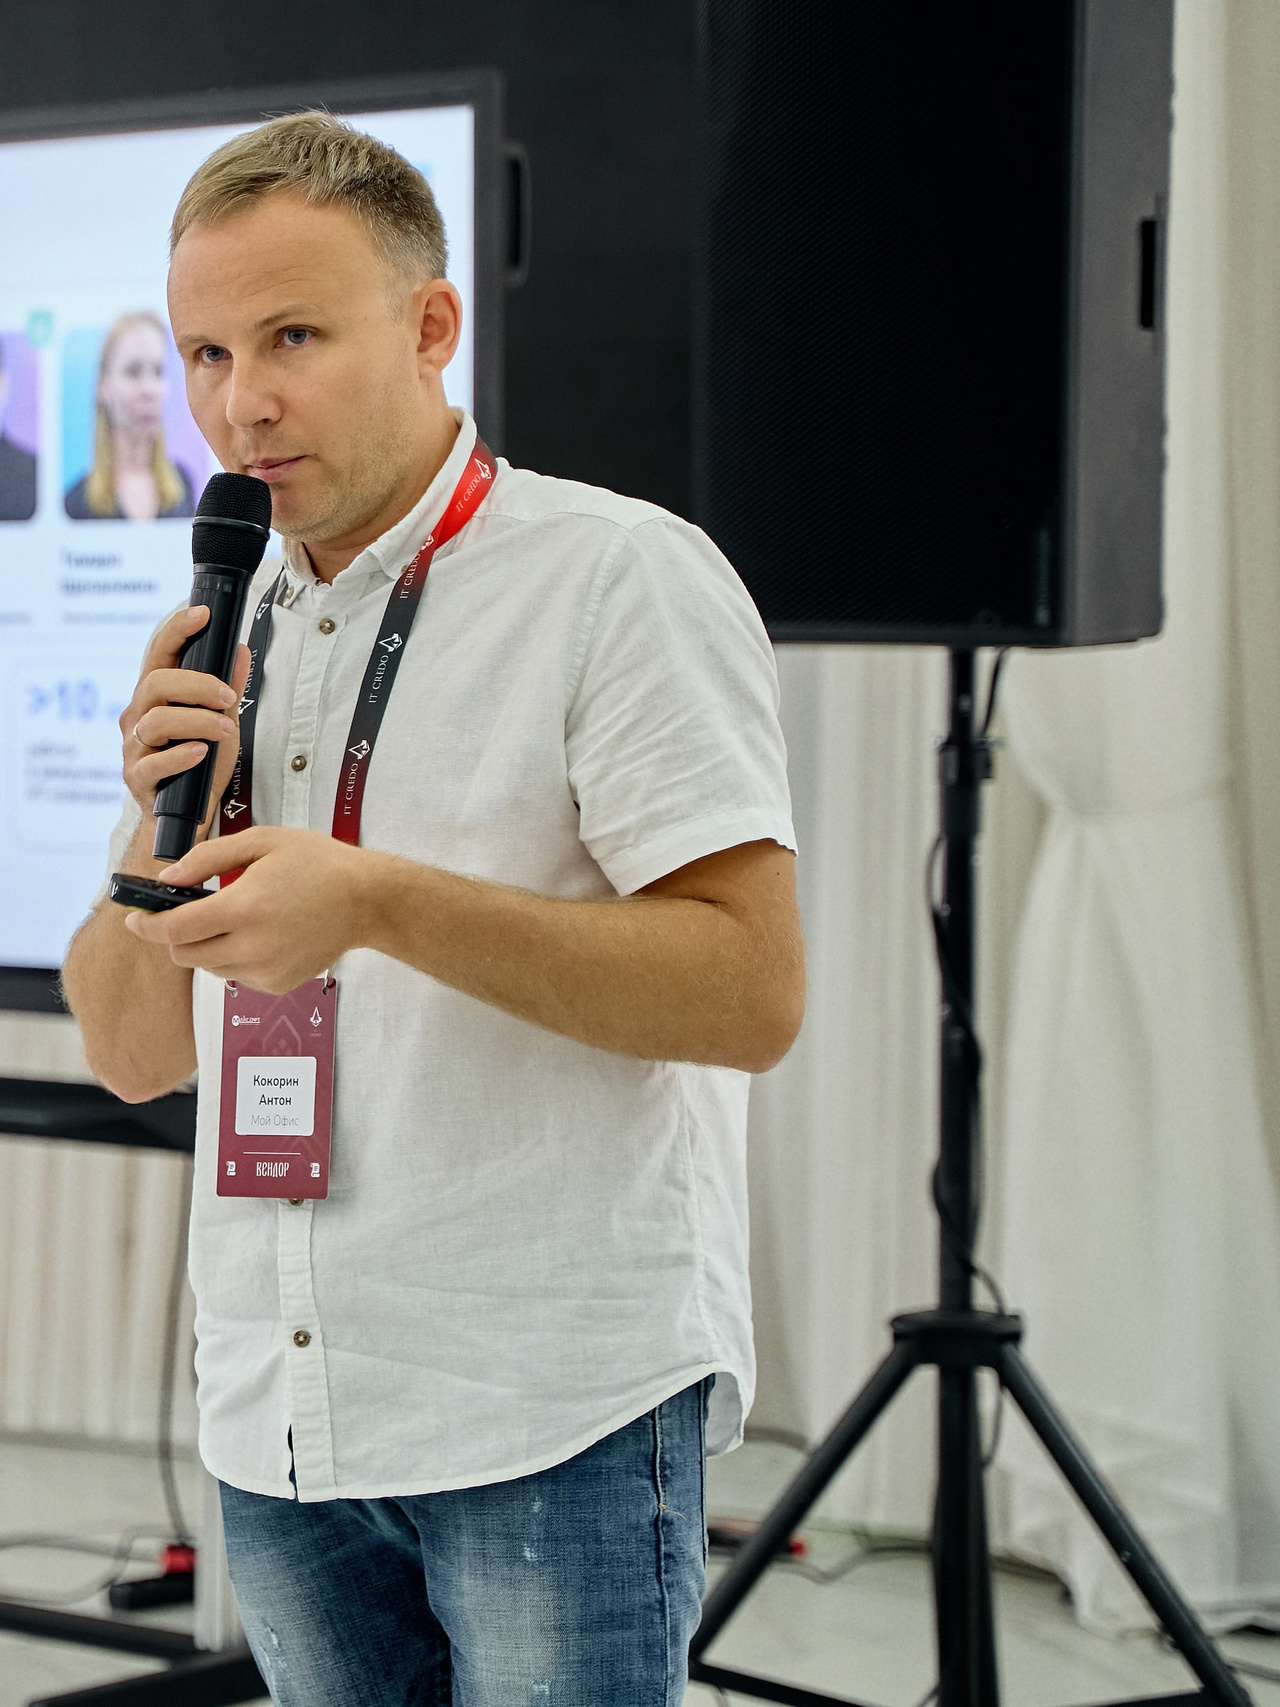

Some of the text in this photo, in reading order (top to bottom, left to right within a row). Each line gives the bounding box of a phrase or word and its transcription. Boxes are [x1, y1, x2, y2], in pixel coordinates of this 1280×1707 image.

[456, 474, 481, 512] IT CREDO
[399, 589, 410, 599] IT
[368, 654, 389, 703] IT CREDO
[343, 762, 359, 815] IT CREDO
[253, 1074, 299, 1089] Кокорин
[258, 1094, 292, 1106] Антон
[251, 1114, 300, 1128] Мой Офис
